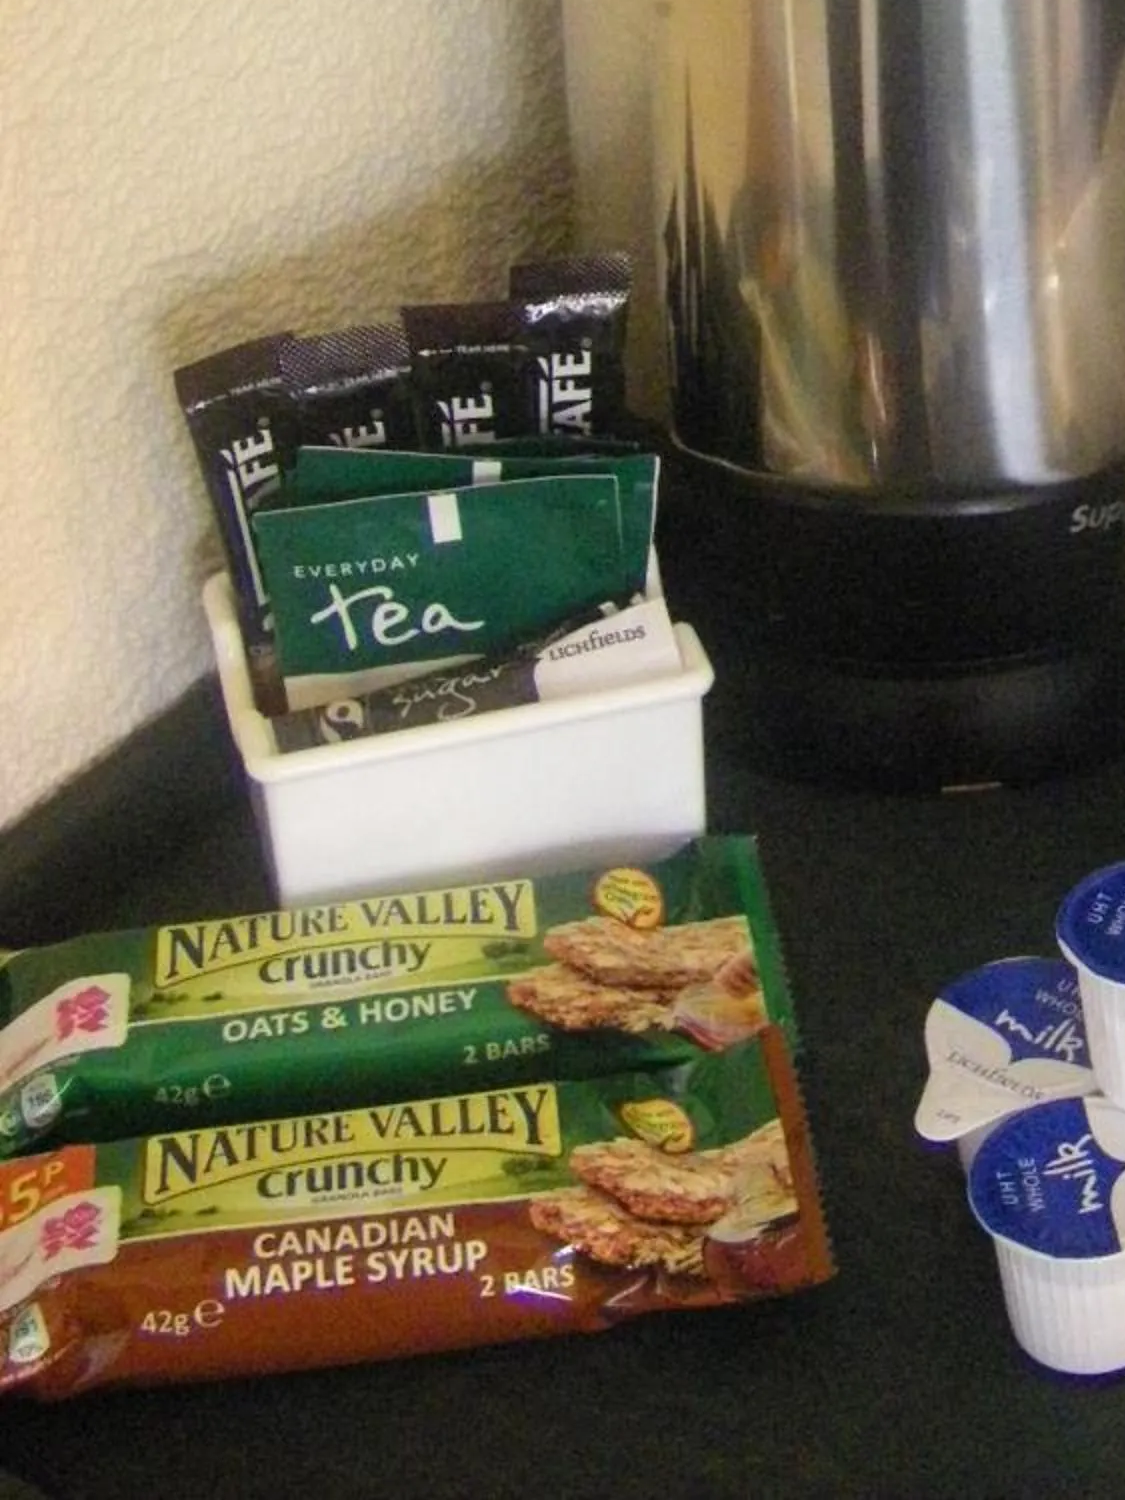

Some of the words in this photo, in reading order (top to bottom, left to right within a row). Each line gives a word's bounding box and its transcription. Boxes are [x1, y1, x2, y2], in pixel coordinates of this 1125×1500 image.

[294, 553, 420, 579] EVERYDAY
[310, 583, 486, 651] tea
[391, 665, 503, 721] sugar
[166, 905, 347, 980] NATURE
[359, 882, 526, 932] VALLEY
[258, 939, 432, 985] crunchy
[221, 1009, 310, 1044] OATS
[320, 1007, 347, 1031] &
[359, 987, 478, 1026] HONEY
[462, 1045, 478, 1065] 2
[485, 1033, 552, 1063] BARS
[155, 1113, 356, 1197] NATURE
[368, 1087, 549, 1146] VALLEY
[256, 1153, 448, 1200] crunchy
[1017, 1157, 1046, 1213] WHOLE
[252, 1212, 456, 1261] CANADIAN
[224, 1254, 355, 1300] MAPLE
[366, 1239, 489, 1283] SYRUP
[479, 1275, 496, 1299] 2
[504, 1264, 576, 1294] BARS
[139, 1309, 192, 1336] 42g
